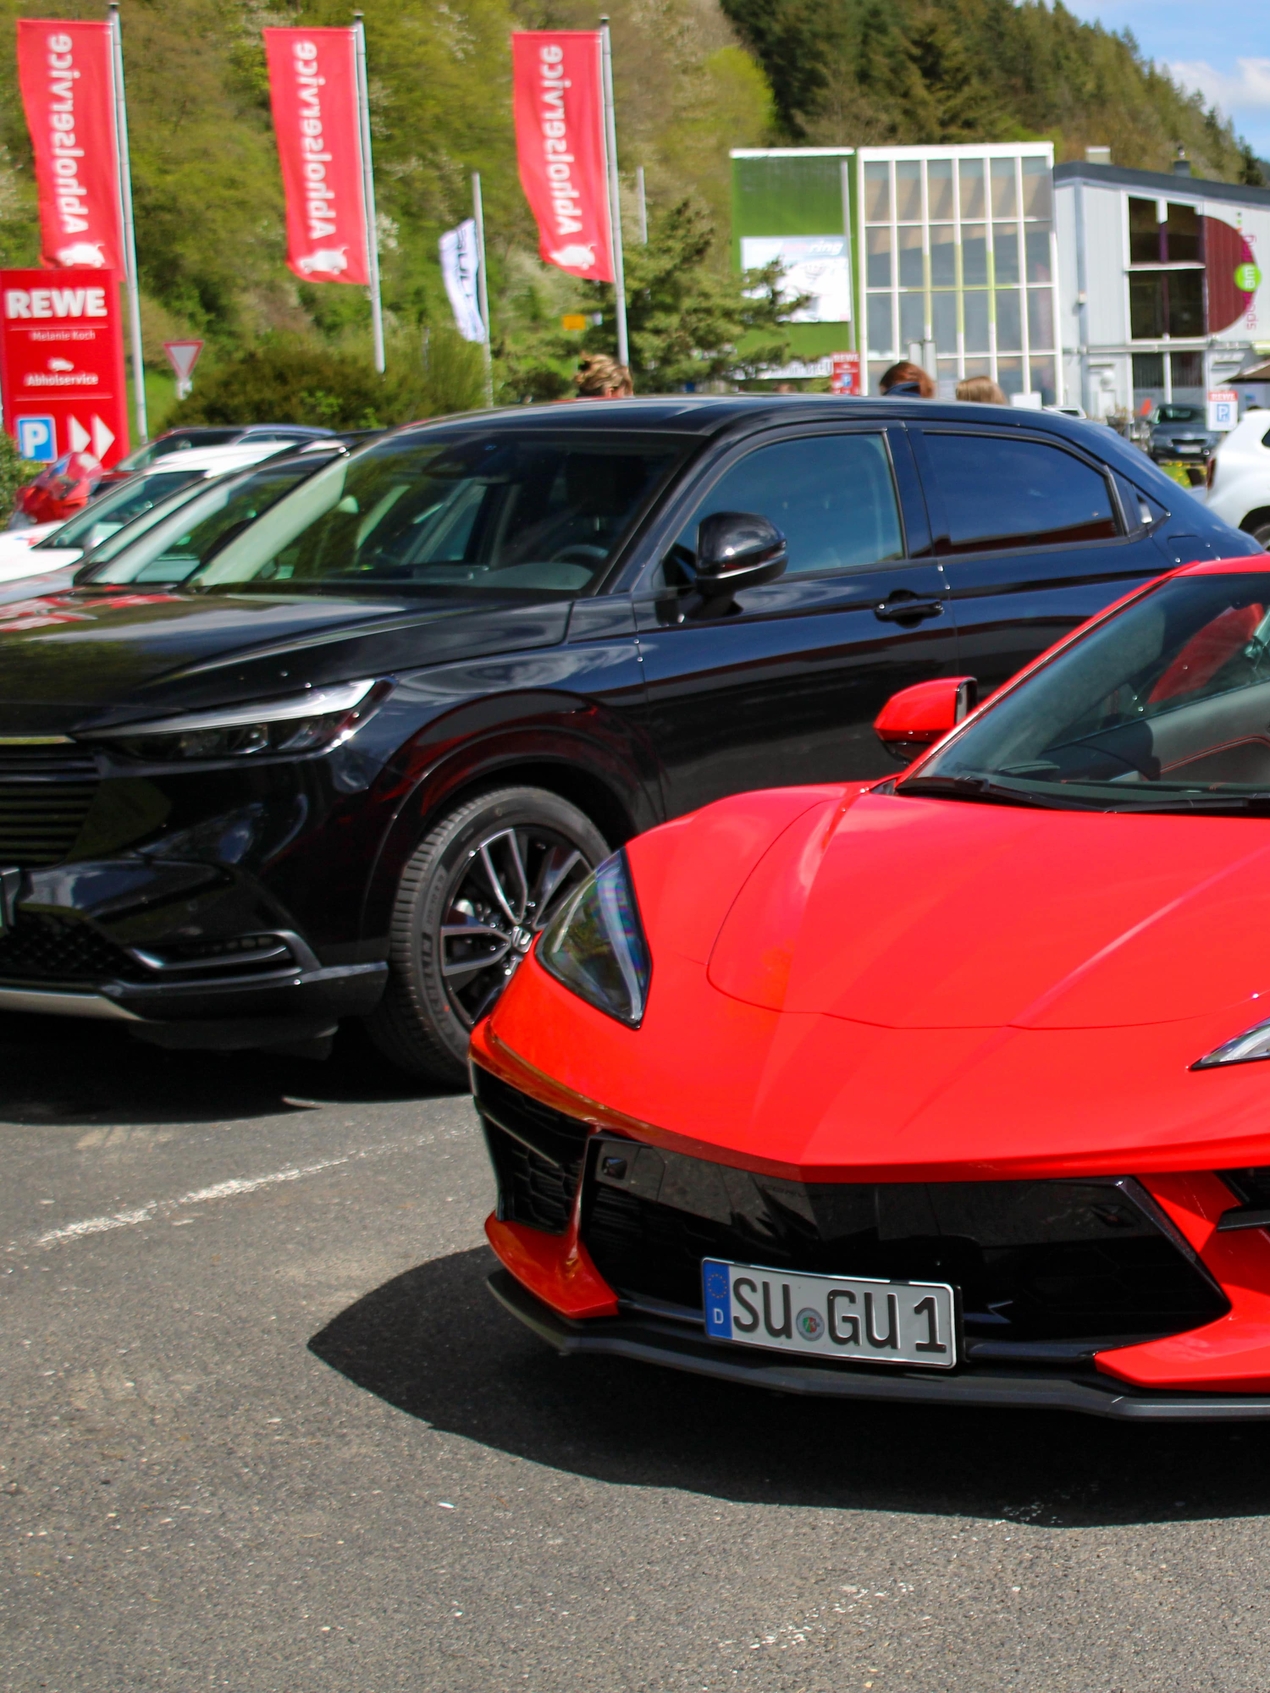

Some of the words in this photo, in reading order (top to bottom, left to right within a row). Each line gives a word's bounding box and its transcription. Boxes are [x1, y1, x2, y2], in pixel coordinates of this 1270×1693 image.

[6, 287, 108, 319] REWE
[31, 331, 70, 341] Melanie
[72, 330, 96, 340] Koch
[25, 373, 99, 386] Abholservice
[22, 421, 49, 458] P
[713, 1308, 724, 1324] D
[732, 1277, 793, 1339] SU
[827, 1289, 901, 1349] GU
[913, 1296, 947, 1353] 1
